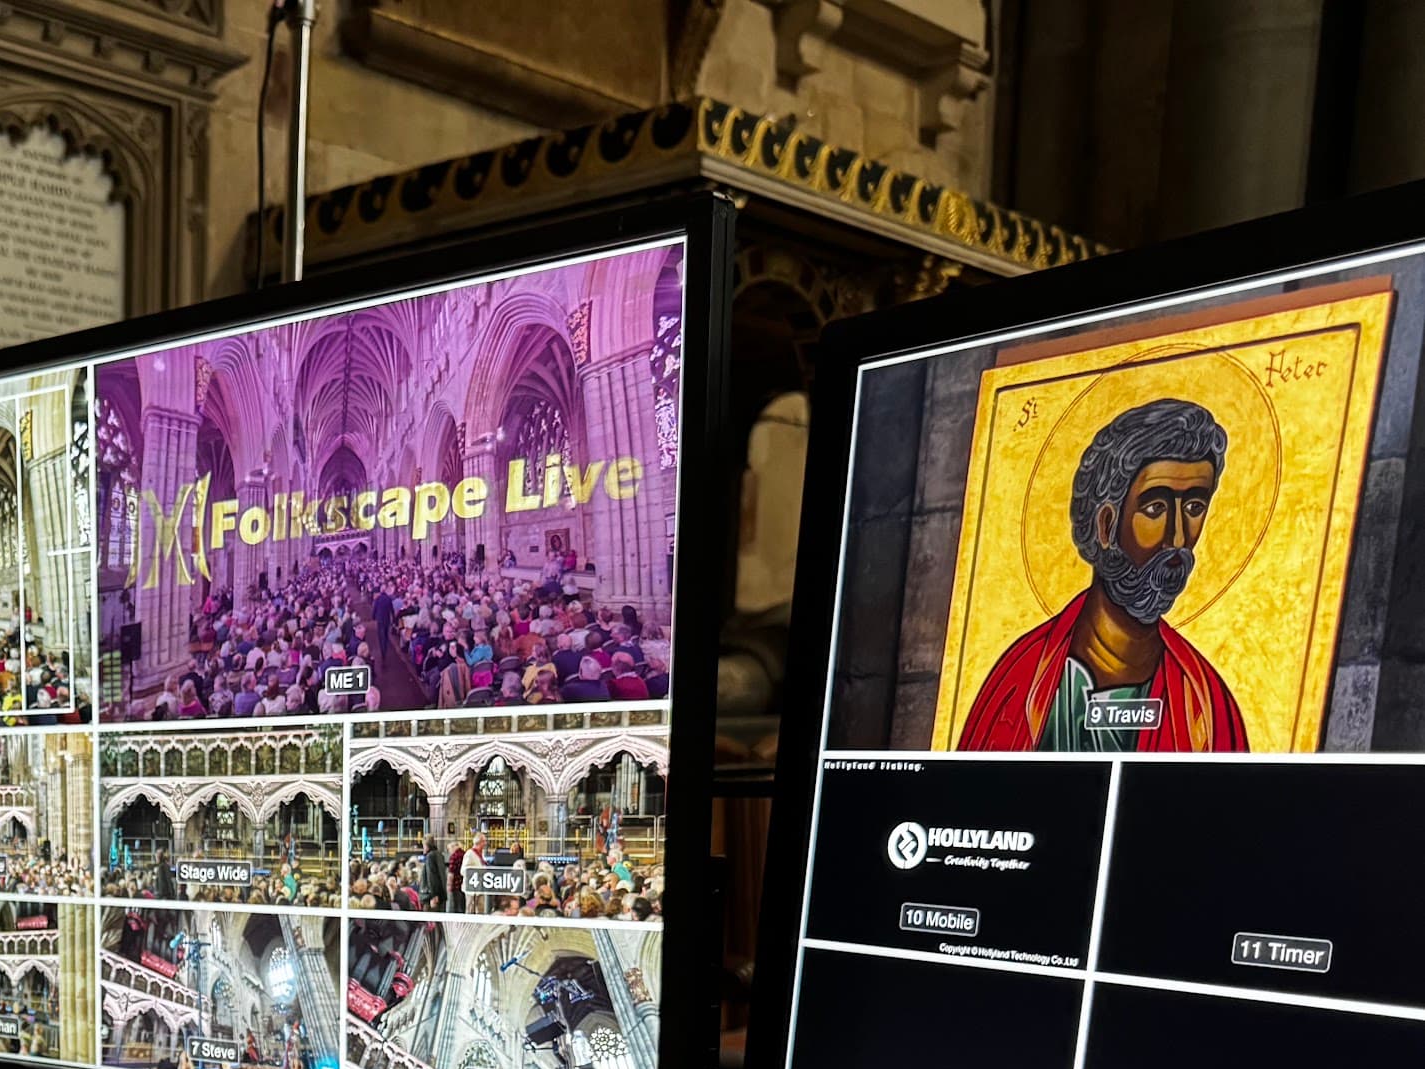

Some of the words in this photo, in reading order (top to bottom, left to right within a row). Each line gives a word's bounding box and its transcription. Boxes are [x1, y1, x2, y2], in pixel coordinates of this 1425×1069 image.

[1265, 350, 1328, 389] Peter
[211, 471, 488, 549] Folkscape
[506, 453, 644, 513] Live
[329, 672, 354, 690] ME
[356, 671, 365, 688] 1
[1090, 706, 1102, 724] 9
[1106, 705, 1156, 724] Travis
[928, 827, 1035, 852] HOLLYLAND
[180, 864, 215, 883] Stage
[217, 866, 248, 883] Wide
[944, 855, 990, 870] Creativity
[990, 857, 1031, 872] Together
[469, 871, 479, 888] 4
[482, 872, 521, 892] Sally
[906, 909, 924, 926] 10
[925, 910, 975, 931] Mobile
[939, 942, 971, 957] Copyright
[978, 947, 1010, 960] Hollyland
[1010, 950, 1050, 966] Technology
[1240, 940, 1262, 959] 11
[1268, 941, 1326, 965] Timer
[191, 1041, 198, 1056] 7
[201, 1042, 236, 1061] Steve
